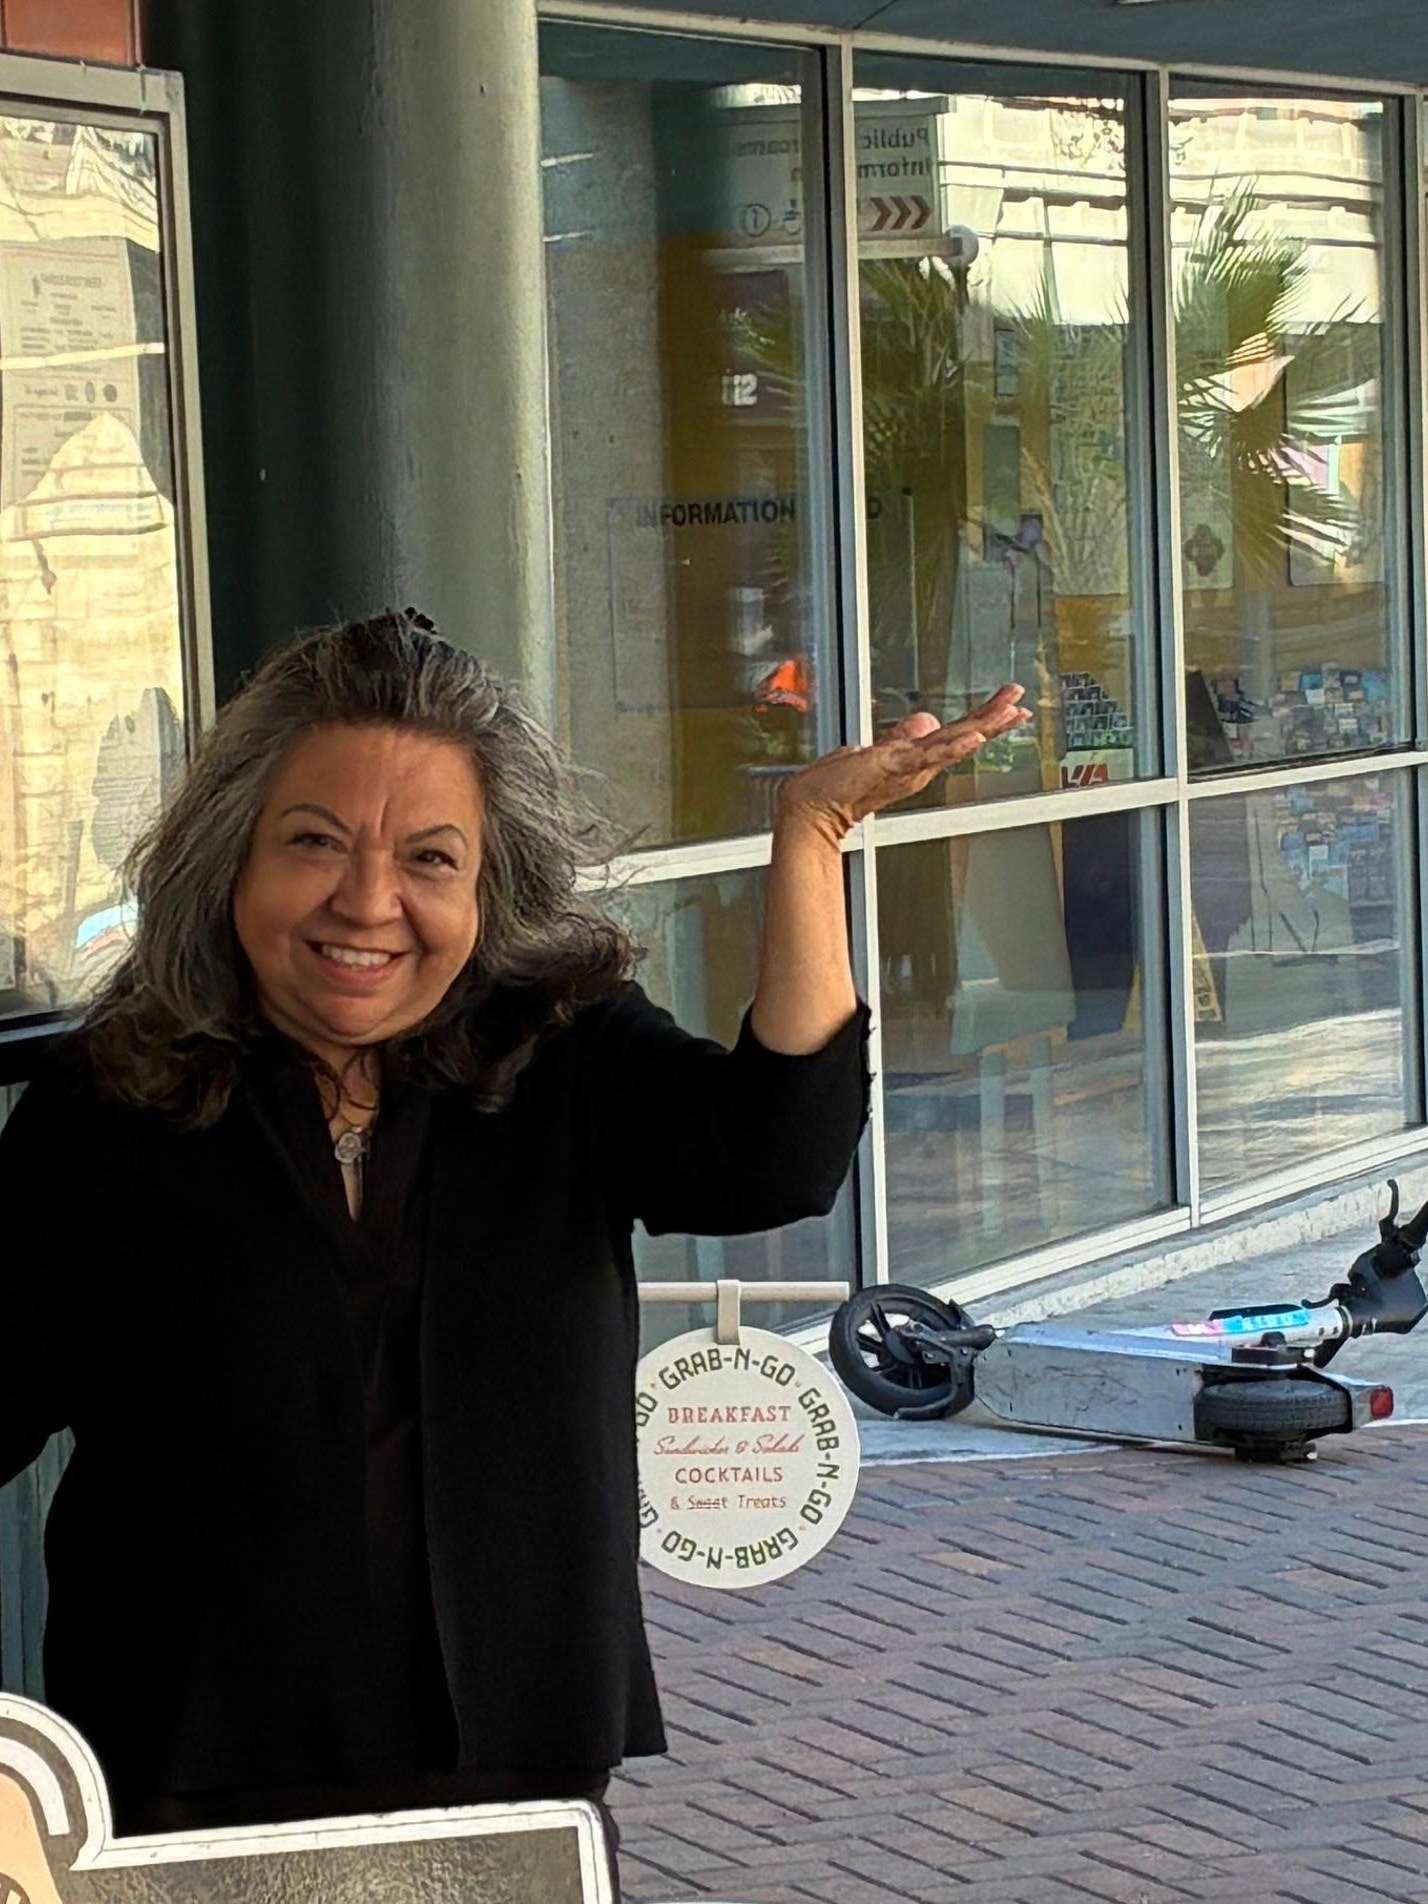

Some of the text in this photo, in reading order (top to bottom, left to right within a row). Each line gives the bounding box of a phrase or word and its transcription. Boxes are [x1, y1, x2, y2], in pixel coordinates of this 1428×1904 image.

[635, 499, 796, 528] INFORMATION
[658, 1347, 796, 1390] GRAB-N-GO
[668, 1405, 792, 1424] BREAKFAST
[798, 1386, 840, 1525] GRAB-N-GO
[675, 1466, 784, 1484] COCKTAILS
[738, 1494, 787, 1509] Treats
[661, 1526, 799, 1571] GRAB-N-GO
